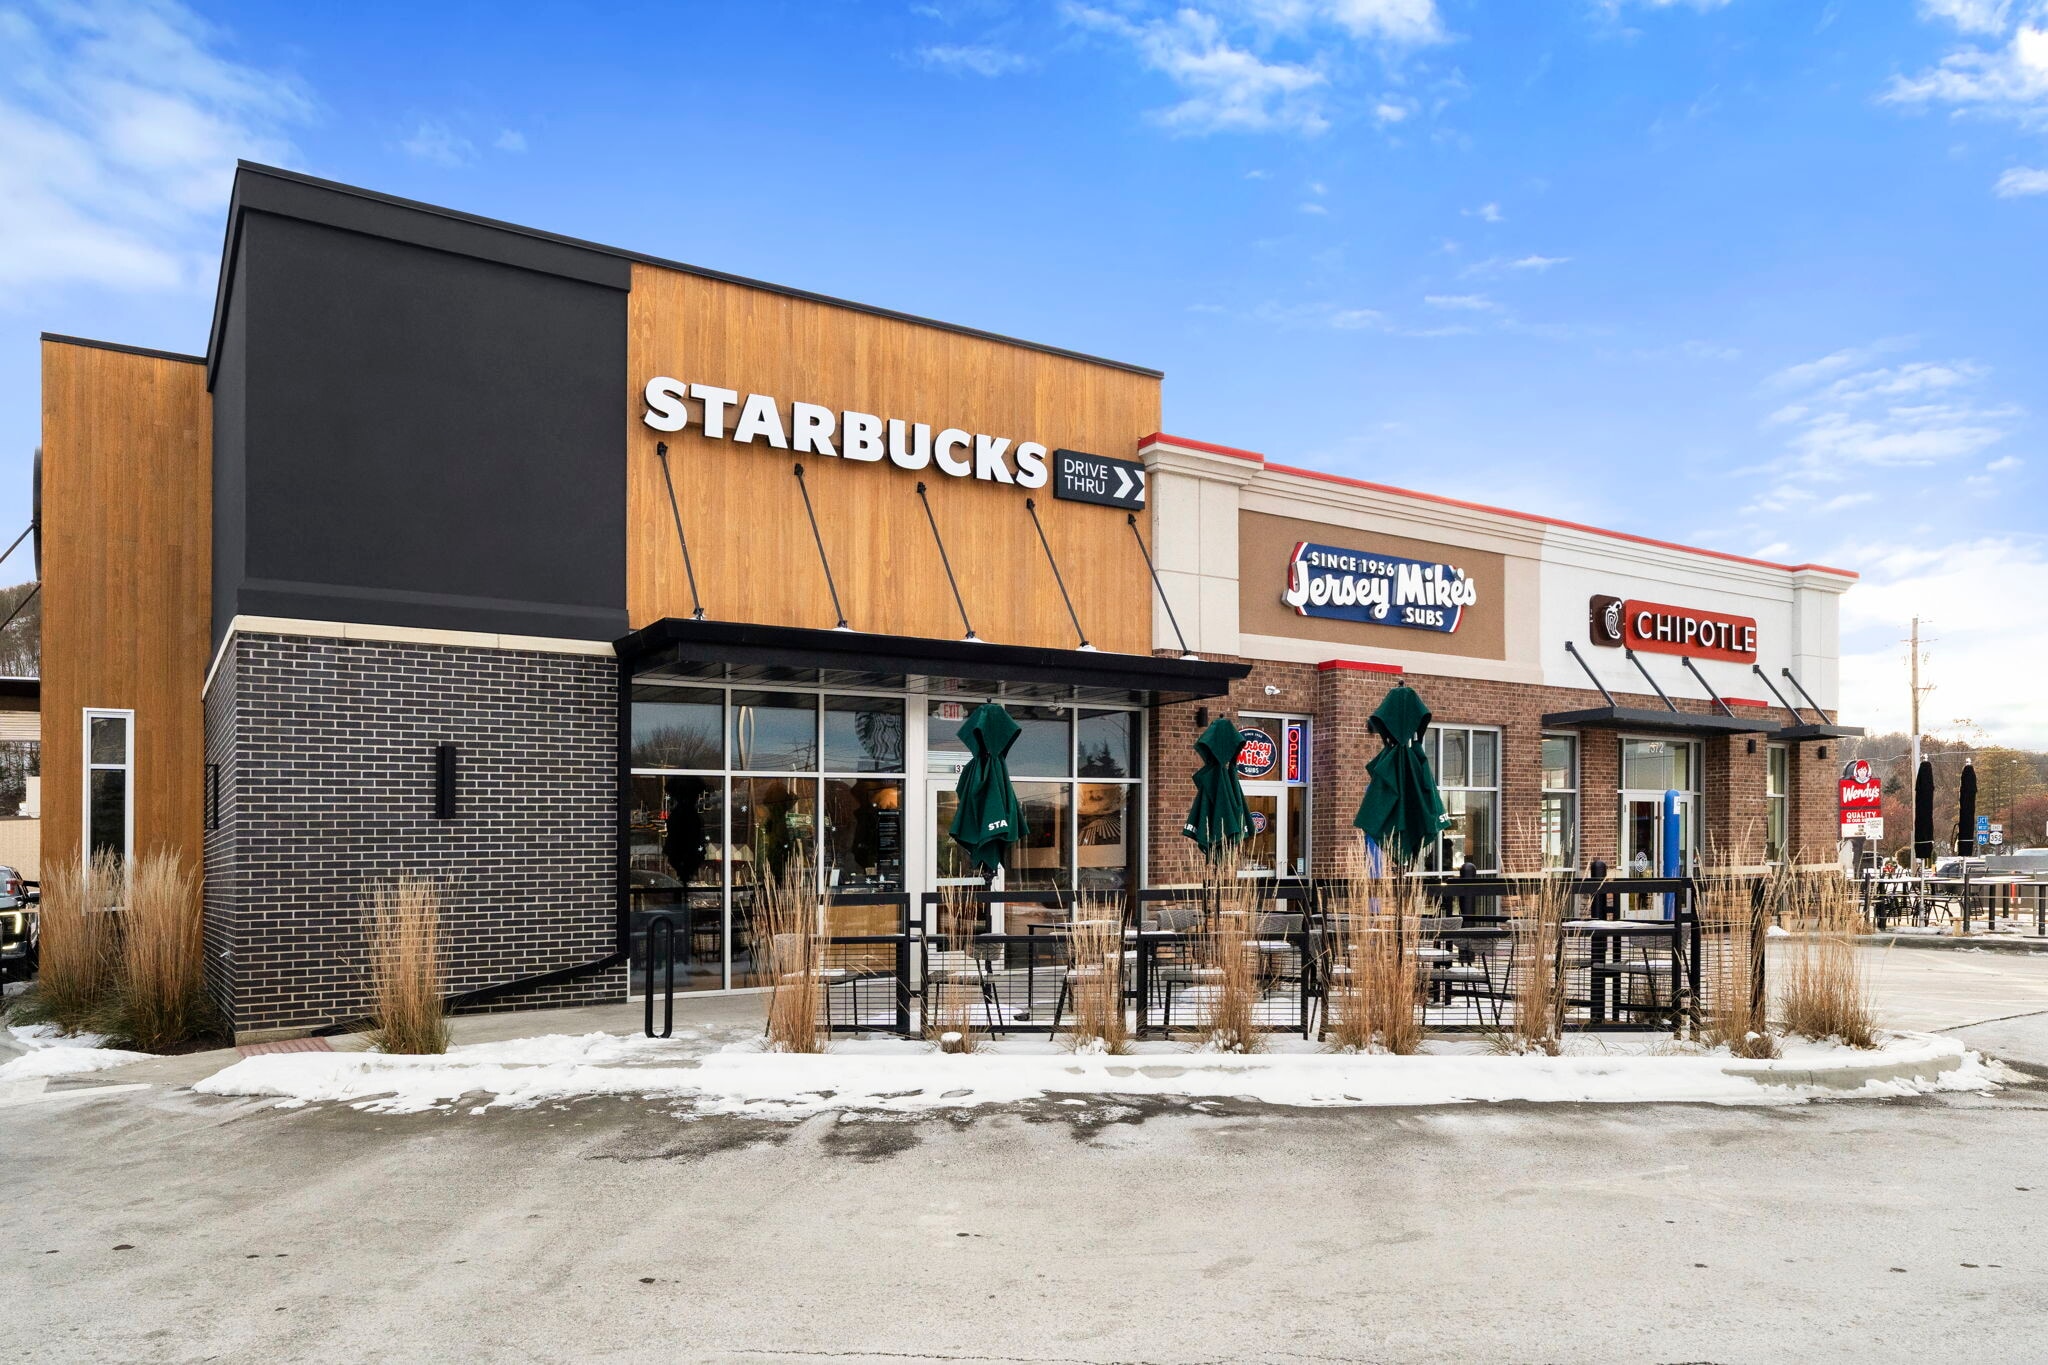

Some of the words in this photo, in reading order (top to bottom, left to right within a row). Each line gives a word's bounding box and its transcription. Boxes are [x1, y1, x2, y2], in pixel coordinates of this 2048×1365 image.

[644, 376, 1048, 489] STARBUCKS
[1064, 458, 1108, 480] DRIVE
[1064, 474, 1105, 495] THRU
[1311, 551, 1357, 572] SINCE
[1361, 559, 1395, 577] 1956
[1287, 560, 1390, 619] Jersey
[1397, 563, 1477, 607] Mike's
[1405, 607, 1444, 627] SUBS
[1637, 611, 1756, 652] CHIPOTLE
[943, 704, 961, 719] EXIT
[1289, 729, 1299, 779] OPEN
[1843, 783, 1879, 803] Wendy's
[1846, 811, 1877, 819] QUALITY
[1990, 834, 2002, 842] 352
